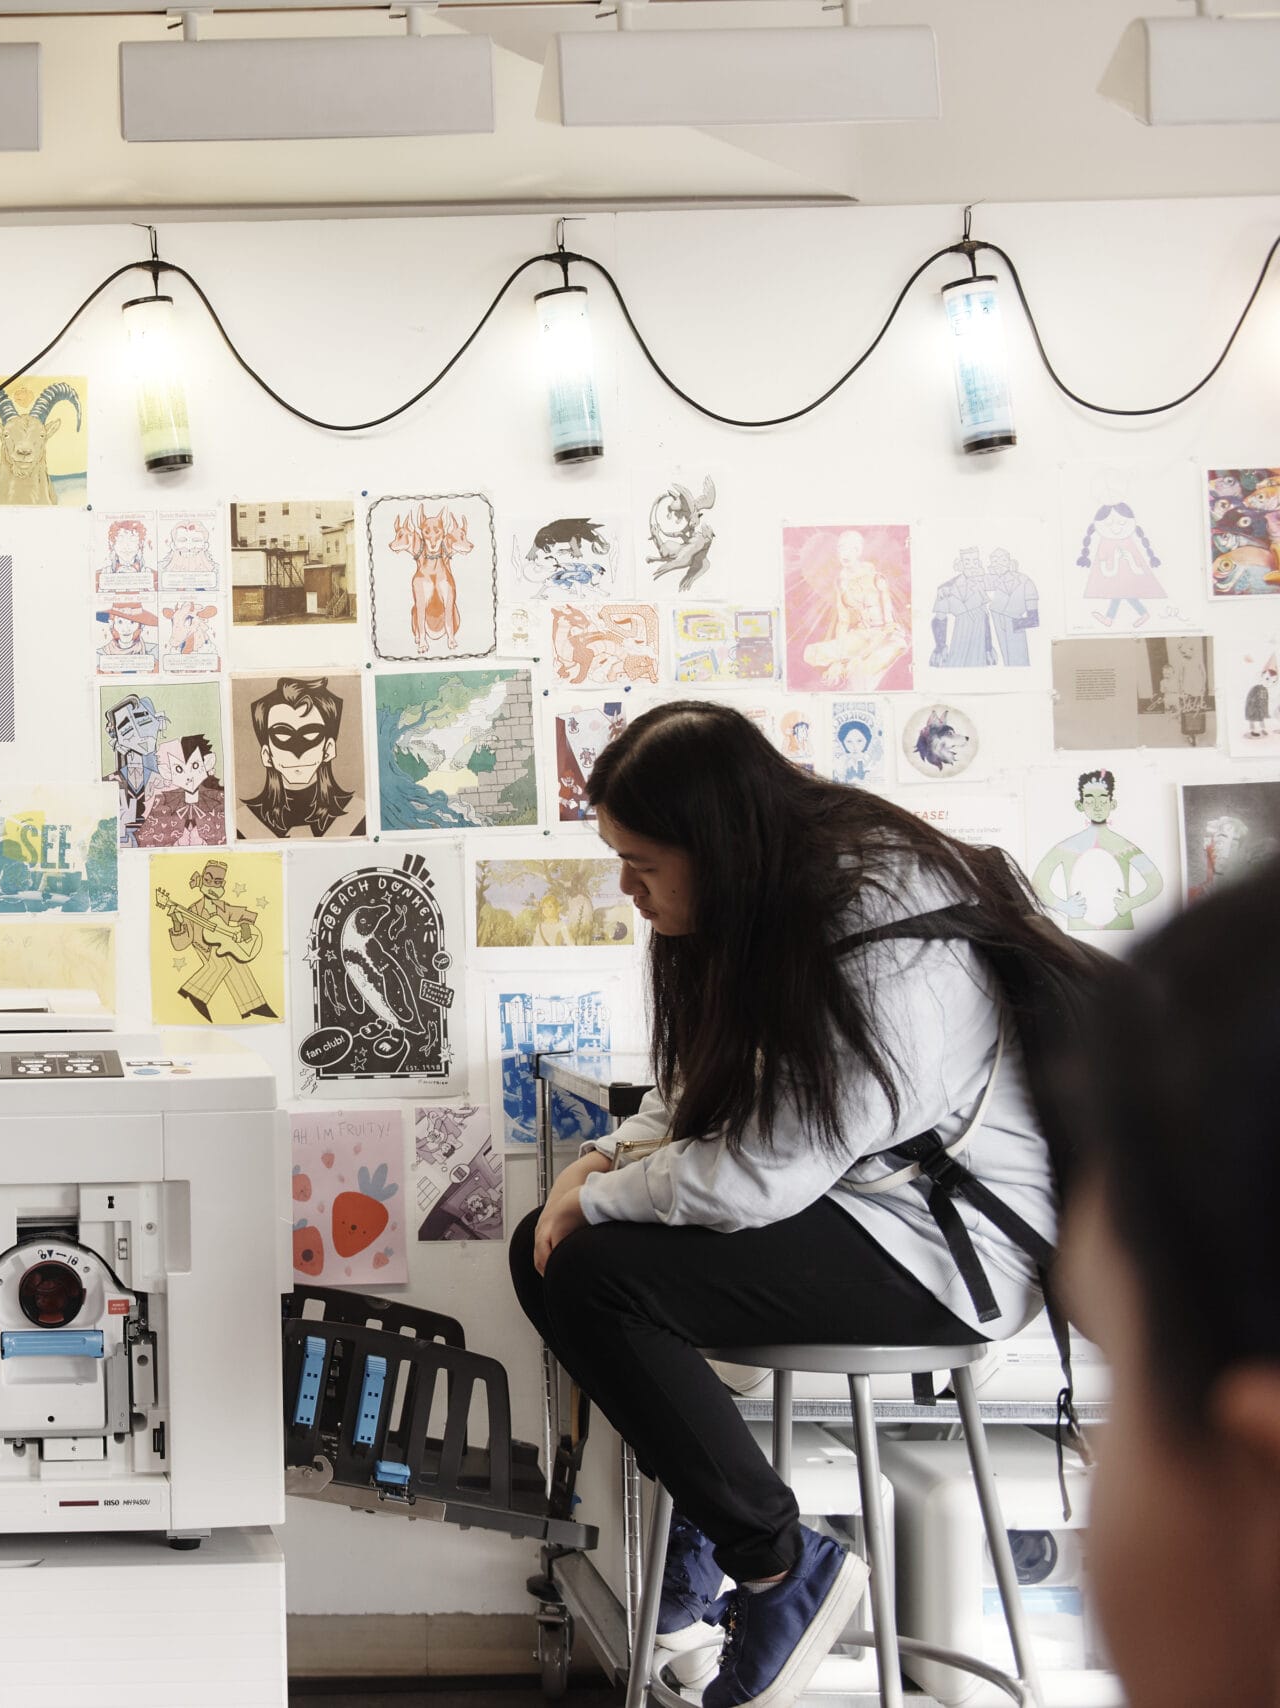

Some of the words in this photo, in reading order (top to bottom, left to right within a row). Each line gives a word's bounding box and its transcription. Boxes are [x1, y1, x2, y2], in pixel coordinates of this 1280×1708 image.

[20, 819, 72, 869] SEE
[323, 879, 369, 930] BEACH
[378, 876, 435, 926] DONKEY
[306, 1047, 322, 1059] fan
[322, 1034, 345, 1051] club!
